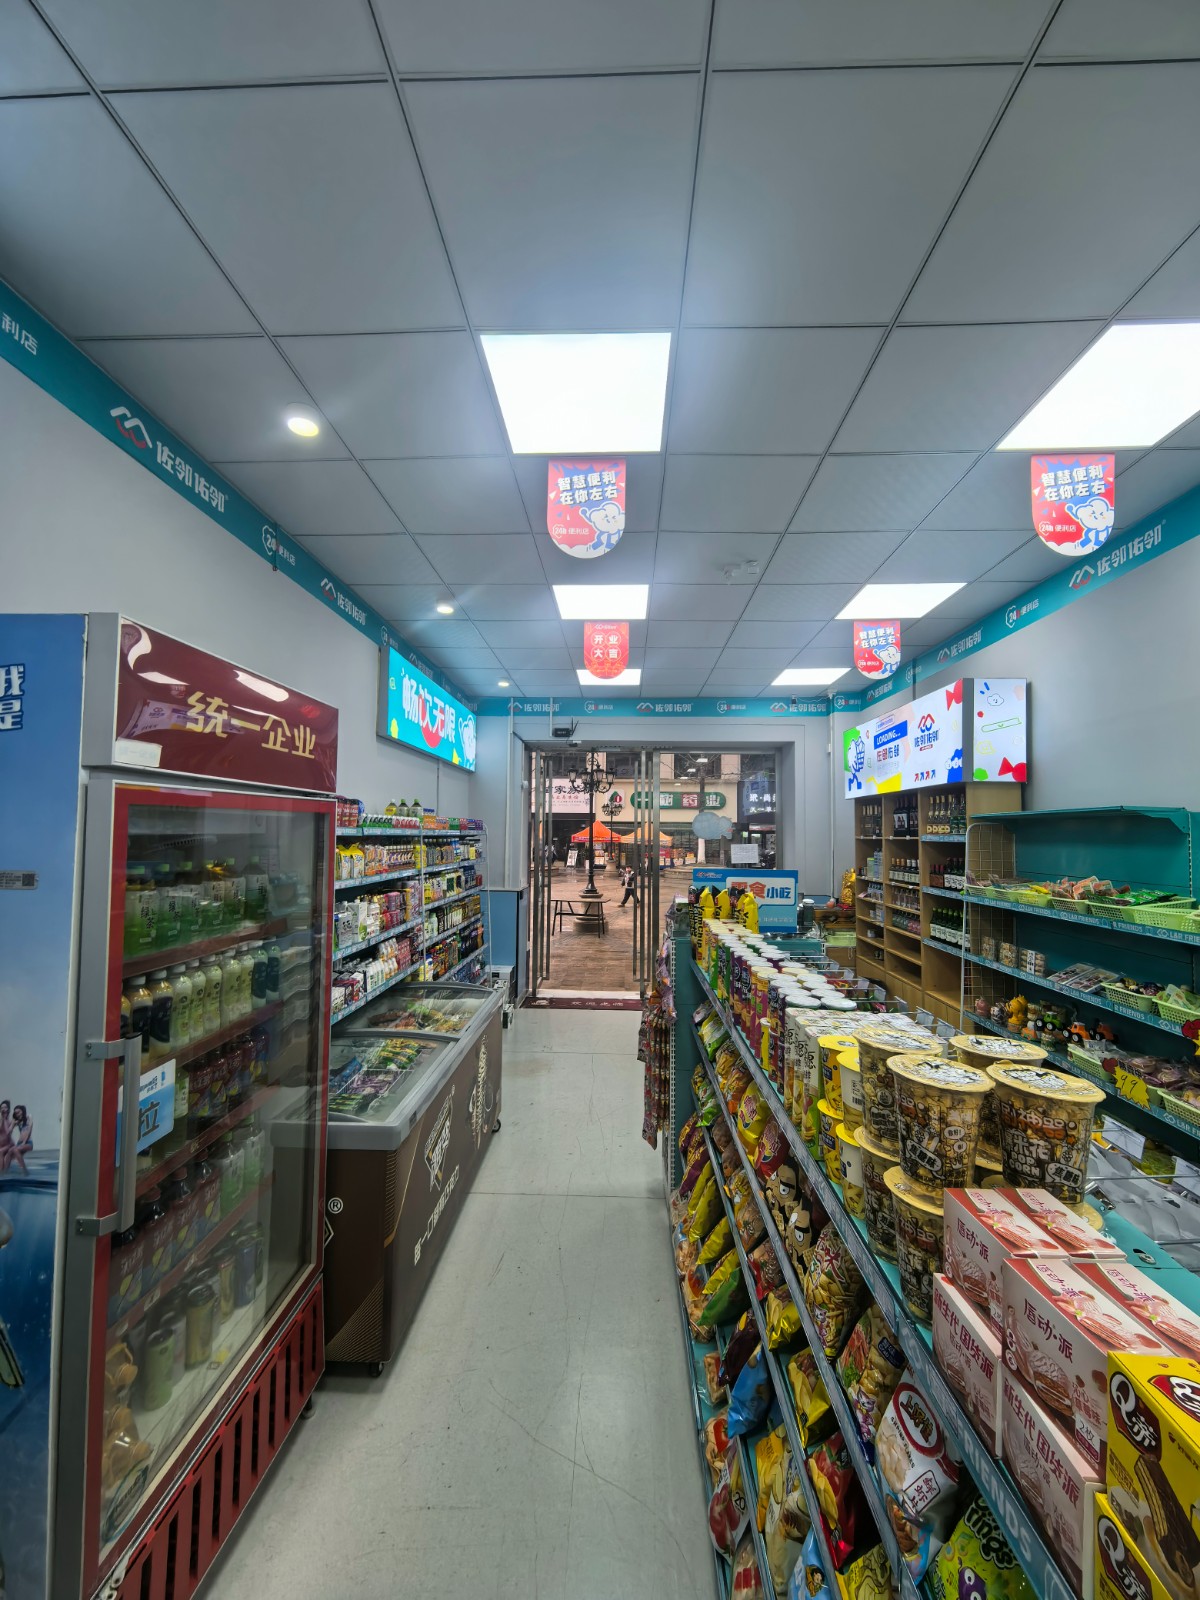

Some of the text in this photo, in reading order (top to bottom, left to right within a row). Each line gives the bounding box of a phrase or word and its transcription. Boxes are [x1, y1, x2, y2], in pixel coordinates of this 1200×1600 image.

[557, 470, 616, 491] 智慧便利
[1041, 465, 1103, 487] 智慧便利
[559, 485, 618, 506] 在你左右
[1044, 480, 1105, 501] 在你左右
[593, 634, 619, 645] 开业
[859, 626, 895, 640] 智慧便利
[860, 635, 896, 649] 在你左右
[593, 646, 619, 659] 大吉
[402, 673, 456, 744] 畅饮无限
[186, 691, 316, 759] 统一企业
[1119, 1006, 1145, 1020] FRIENDS
[1009, 1159, 1040, 1176] CORN
[1024, 1298, 1074, 1364] 唇动·派
[960, 1330, 993, 1383] 国货派
[1003, 1377, 1082, 1505] 新生代 国货派
[956, 1422, 1032, 1563] FRIENDS
